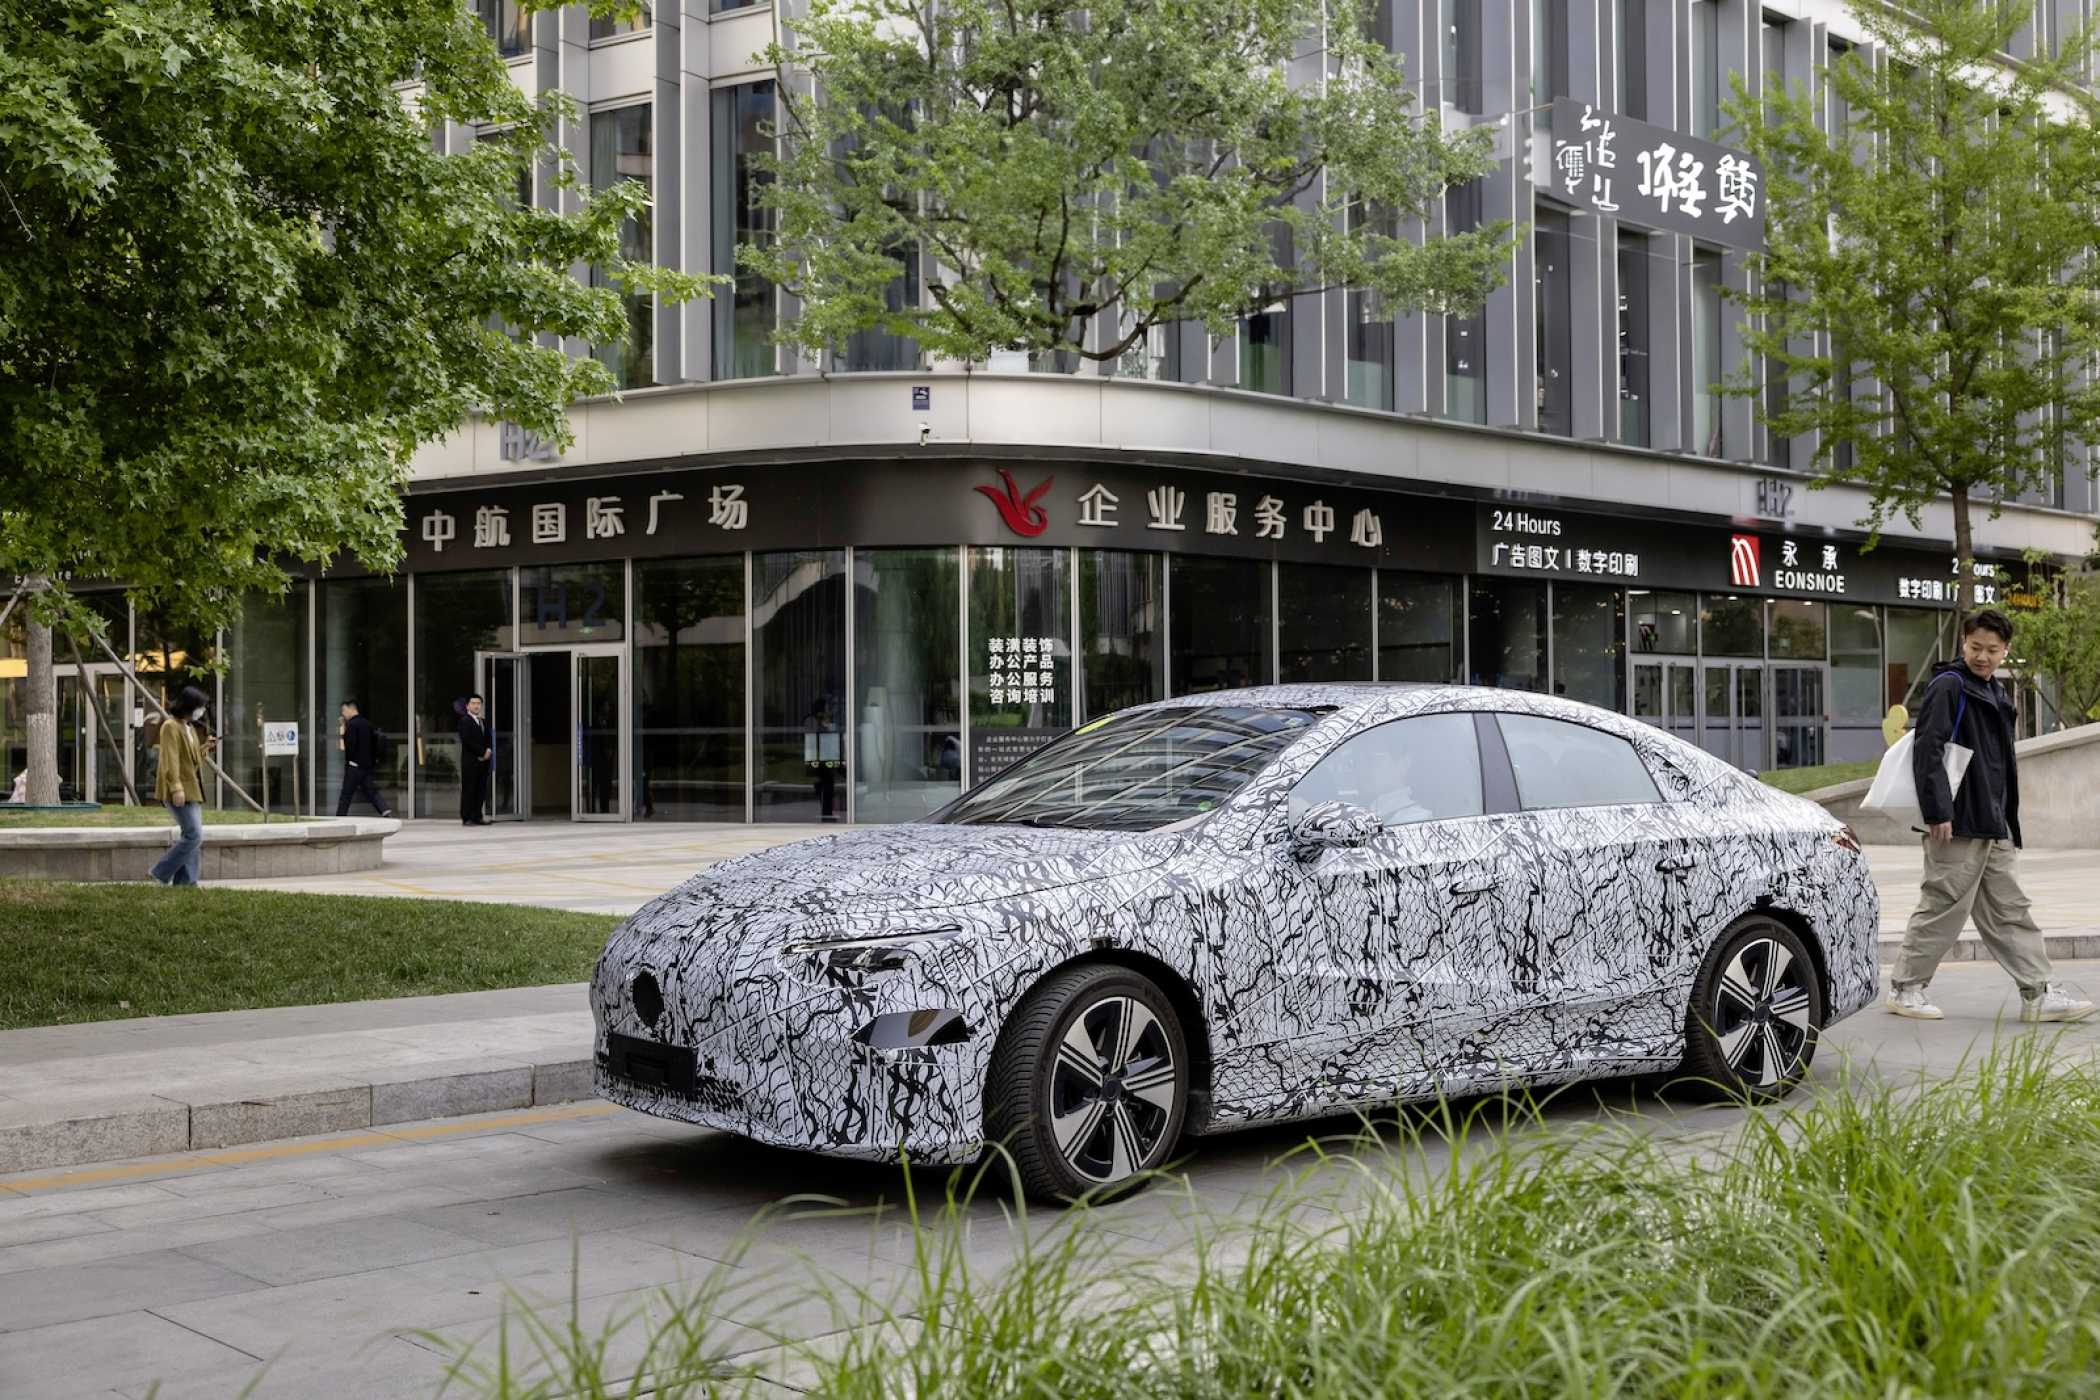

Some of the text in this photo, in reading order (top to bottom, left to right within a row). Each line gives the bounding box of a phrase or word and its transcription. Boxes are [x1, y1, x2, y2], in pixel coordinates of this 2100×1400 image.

[422, 484, 750, 552] 中航国际广场
[1076, 482, 1384, 548] 企业服务中心
[1493, 510, 1562, 536] 24 Hours
[1491, 542, 1560, 571] 广告图文
[1577, 549, 1639, 577] 数字印刷
[1973, 562, 1996, 578] ours
[1775, 570, 1845, 593] EONSNOE
[1898, 577, 1943, 601] 数字印刷
[989, 653, 1054, 670] 办公产品
[989, 671, 1054, 687] 办公服务
[989, 687, 1055, 704] 咨询培训
